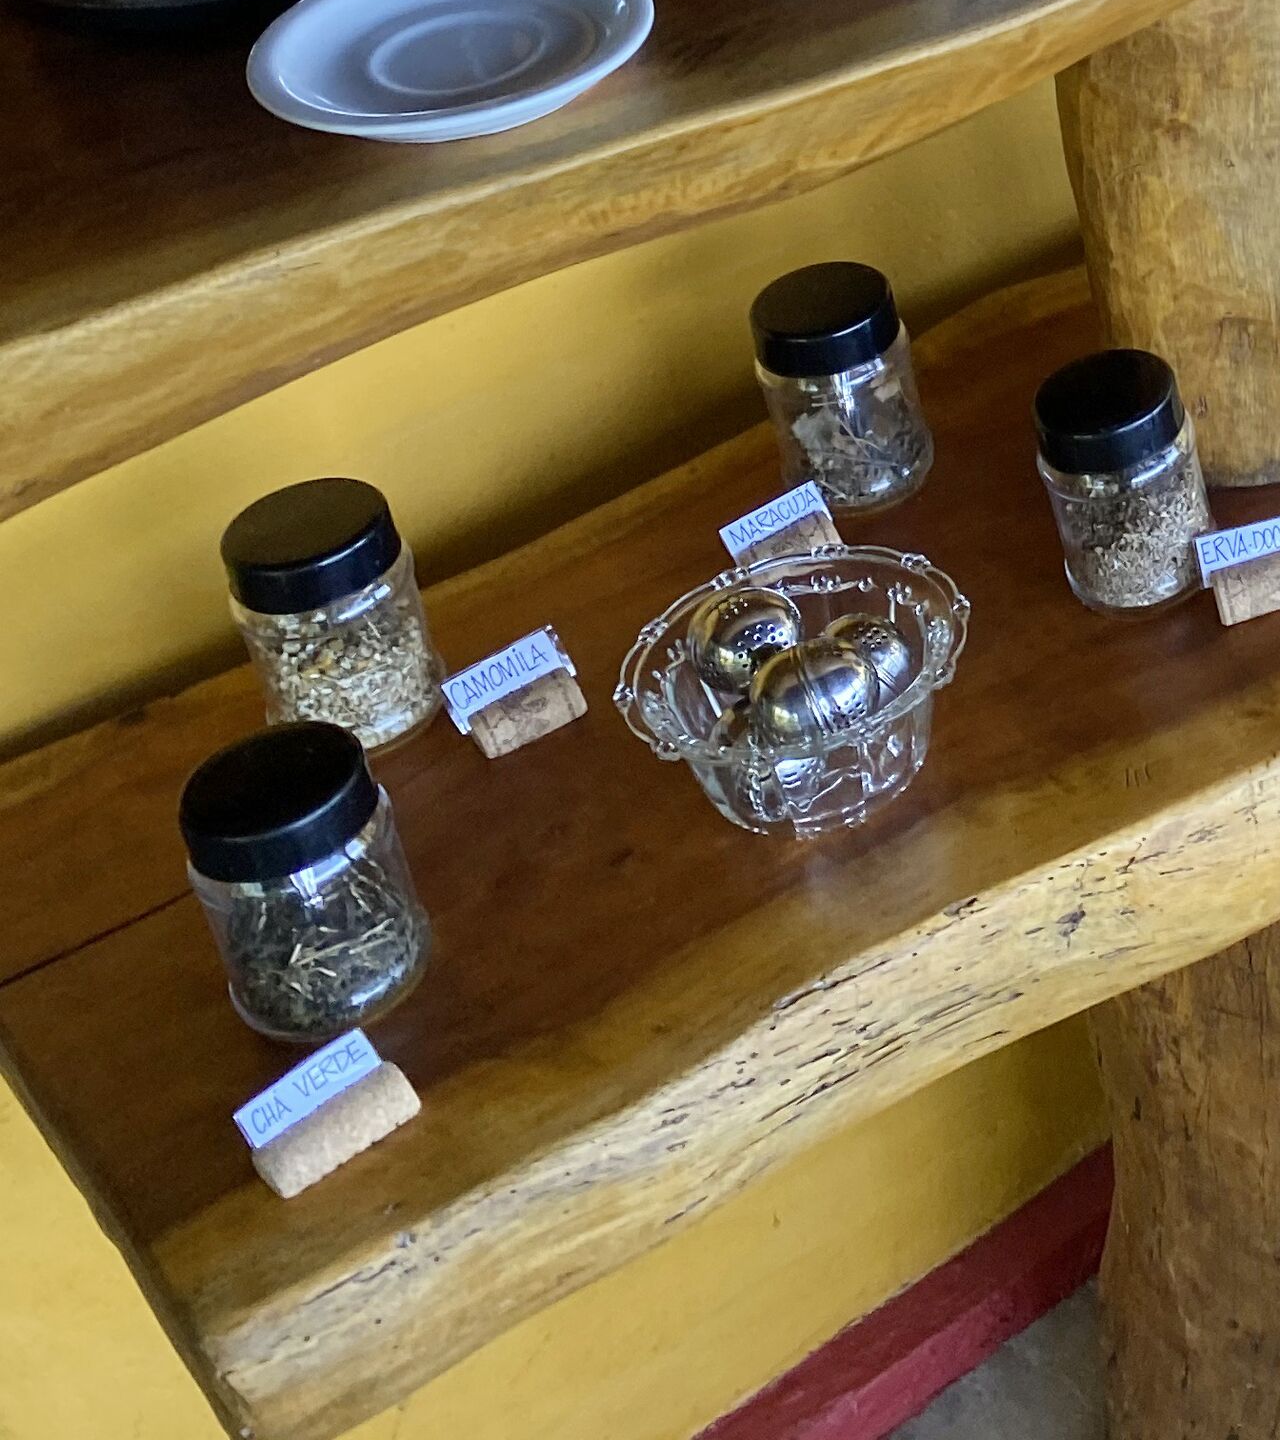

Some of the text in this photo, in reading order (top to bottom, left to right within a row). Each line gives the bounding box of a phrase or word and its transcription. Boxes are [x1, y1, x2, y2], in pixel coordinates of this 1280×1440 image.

[728, 483, 819, 546] MARACUJÁ
[450, 643, 550, 710] CAMOMILA
[292, 1040, 369, 1097] VERDE
